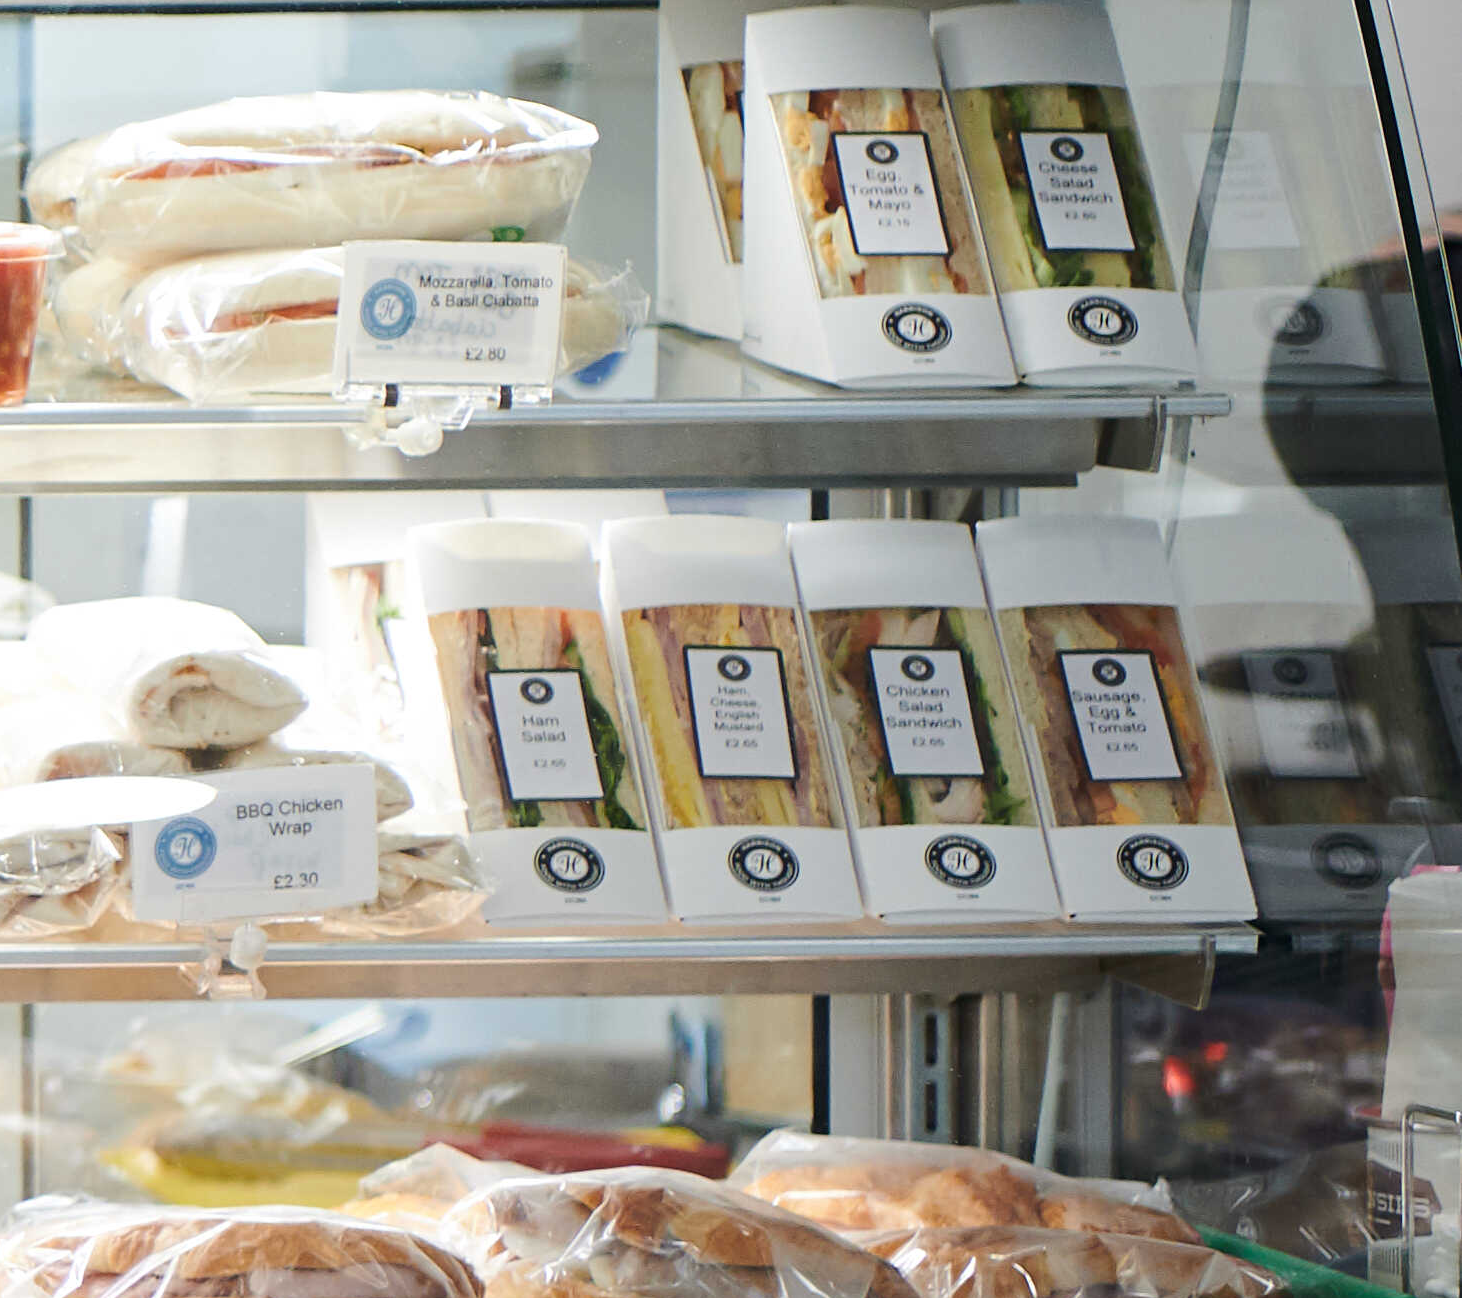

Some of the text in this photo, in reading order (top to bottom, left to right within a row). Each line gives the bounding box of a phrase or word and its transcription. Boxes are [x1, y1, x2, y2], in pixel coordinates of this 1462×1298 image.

[1039, 162, 1098, 175] Cheese
[850, 183, 908, 196] Tomato
[1050, 177, 1094, 189] Salad
[1039, 192, 1113, 204] Sandwich
[502, 273, 554, 288] Tomato
[431, 294, 539, 309] & Basil Ciabatta
[465, 347, 506, 361] £280
[886, 685, 950, 698] Chicken
[899, 700, 944, 713] Salad
[522, 714, 560, 727] Ham
[1088, 707, 1120, 721] Egg
[886, 716, 962, 729] Sandwich
[1087, 721, 1148, 734] Tomato
[522, 730, 566, 743] Salad
[236, 799, 343, 820] BBQ Chicken
[269, 822, 312, 836] Wrap
[274, 872, 318, 890] £2.30
